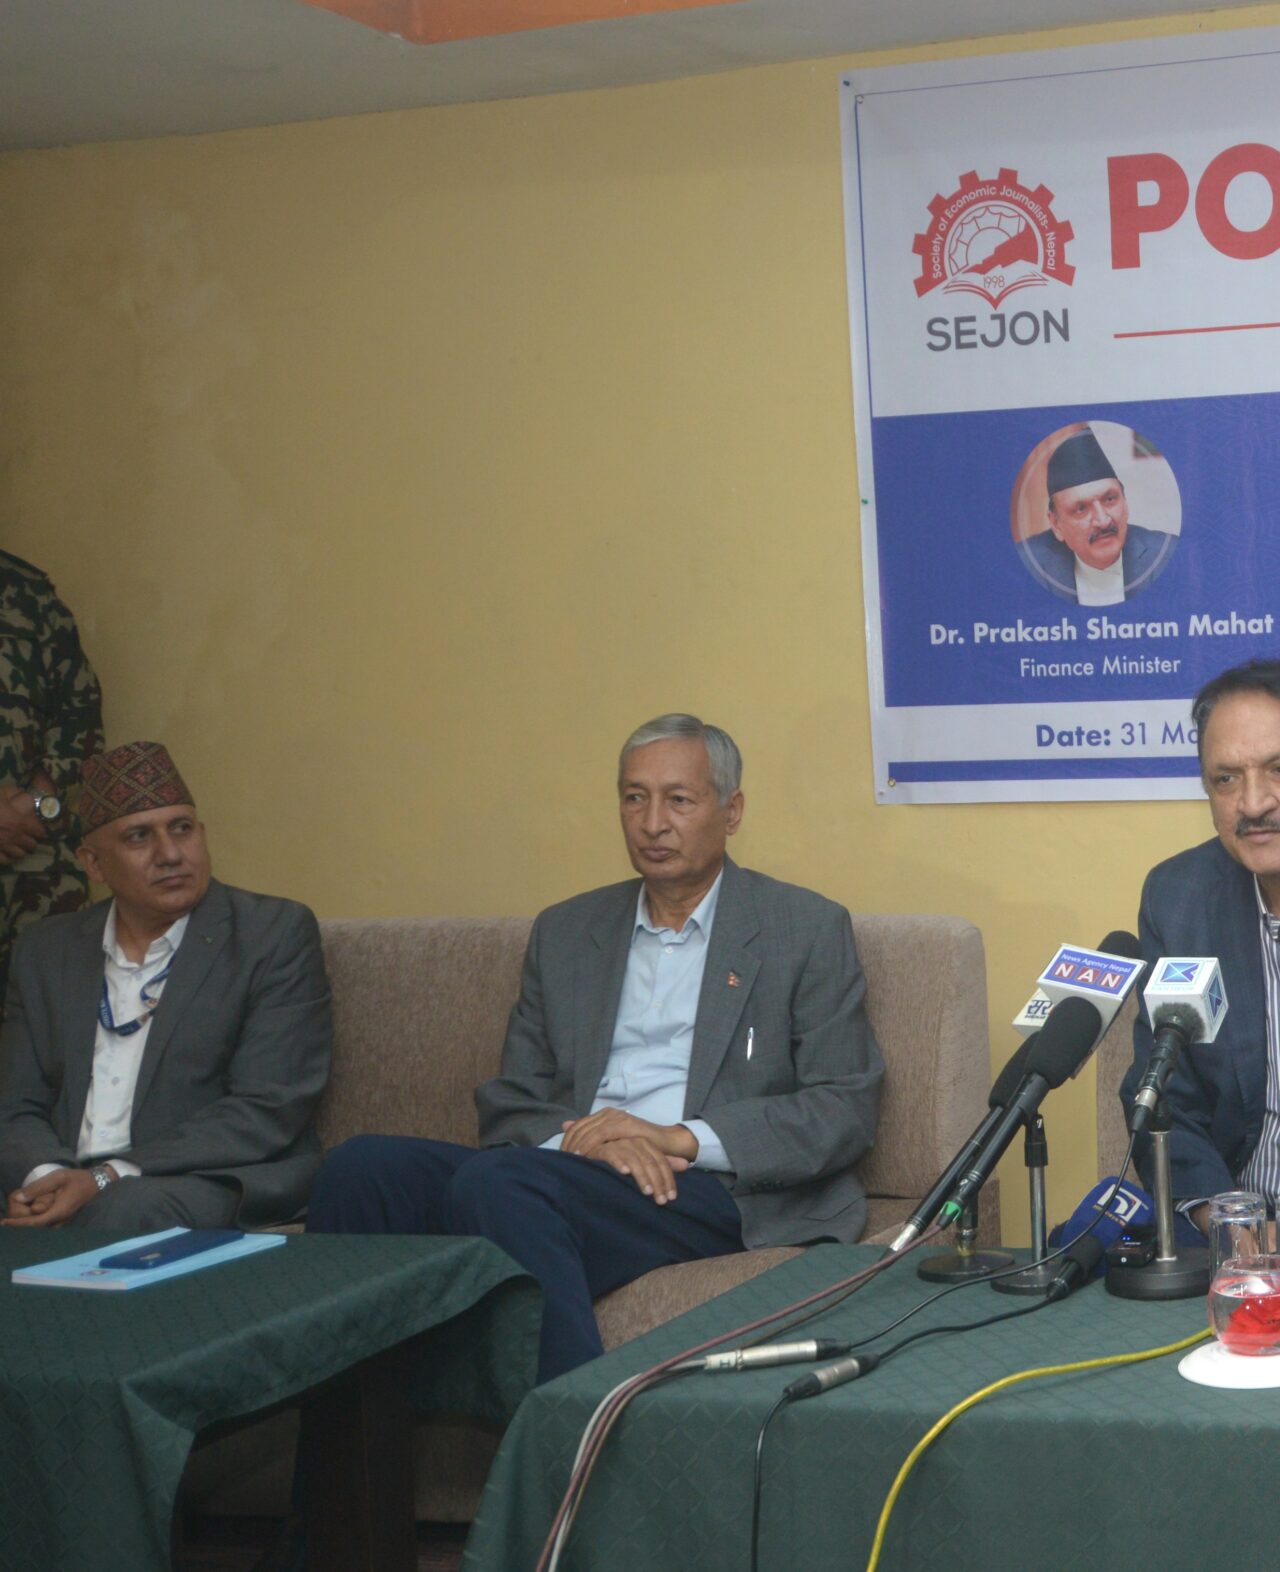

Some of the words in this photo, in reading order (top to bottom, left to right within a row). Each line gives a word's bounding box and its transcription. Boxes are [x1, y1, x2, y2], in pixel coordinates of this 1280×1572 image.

[931, 232, 944, 280] Society
[939, 217, 950, 232] of
[945, 184, 997, 220] Economic
[1045, 231, 1057, 271] Nepal
[982, 275, 1006, 289] 1998
[925, 307, 1070, 352] SEJON
[929, 623, 965, 646] Dr.
[973, 618, 1078, 644] Prakash
[1086, 615, 1179, 641] Sharan
[1188, 611, 1275, 637] Mahat
[1019, 656, 1095, 678] Finance
[1102, 655, 1181, 676] Minister
[1035, 724, 1111, 748] Date:
[1120, 721, 1147, 746] 31
[1160, 720, 1199, 745] Ma
[1061, 953, 1081, 963] News
[1081, 957, 1108, 969] Agency
[1109, 963, 1132, 974] Nepal
